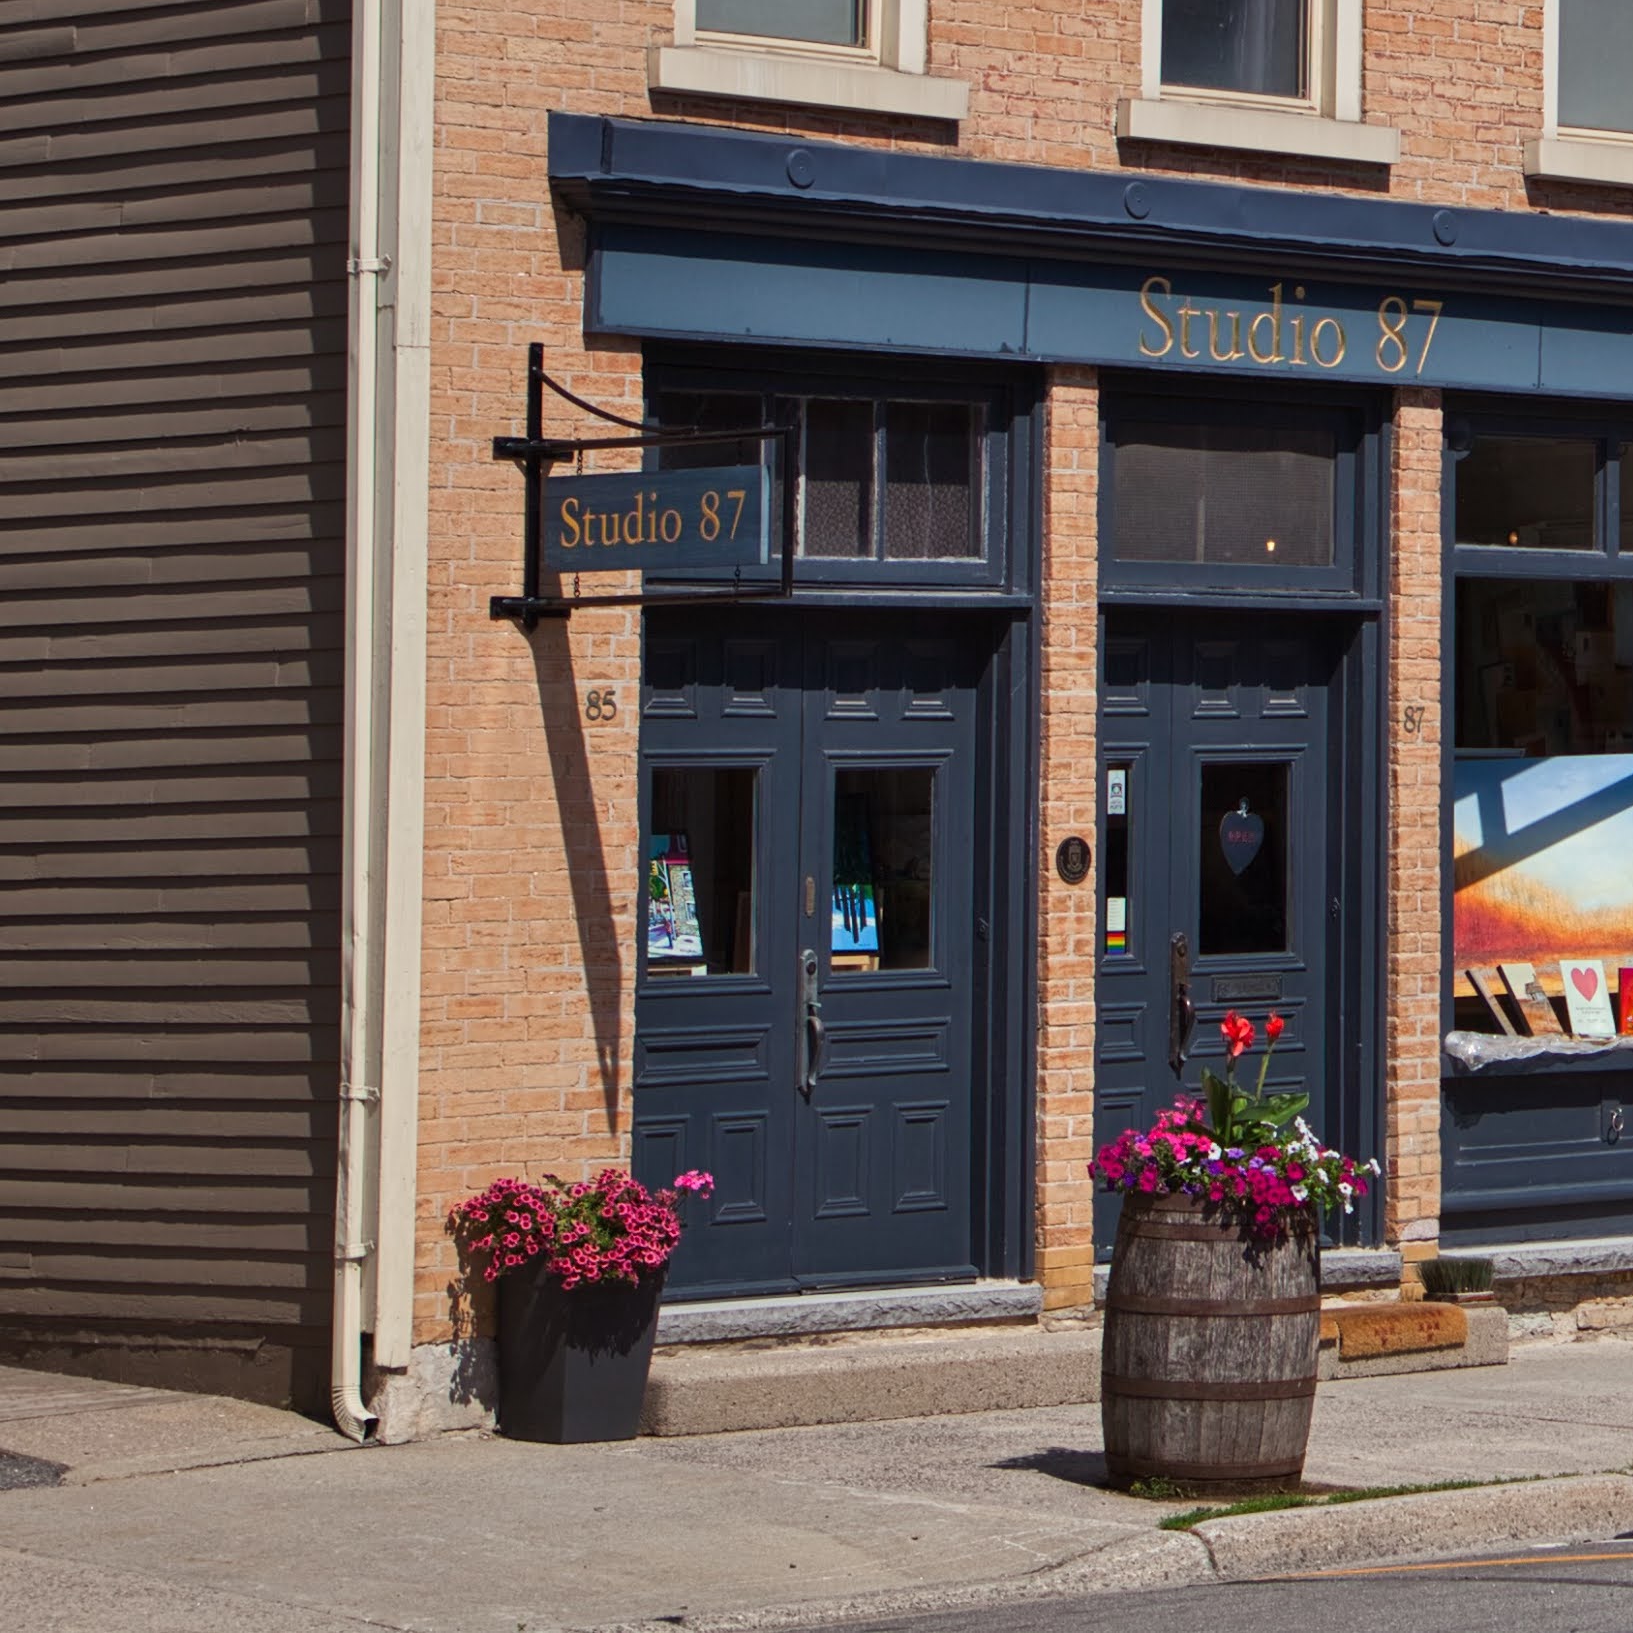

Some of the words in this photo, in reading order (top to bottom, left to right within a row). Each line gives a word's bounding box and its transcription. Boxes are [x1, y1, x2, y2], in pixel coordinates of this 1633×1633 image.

[1140, 276, 1346, 368] Studio
[1375, 296, 1444, 375] 87
[560, 490, 683, 548] Studio
[699, 489, 747, 542] 87
[586, 689, 617, 721] 85
[1403, 705, 1426, 734] 87
